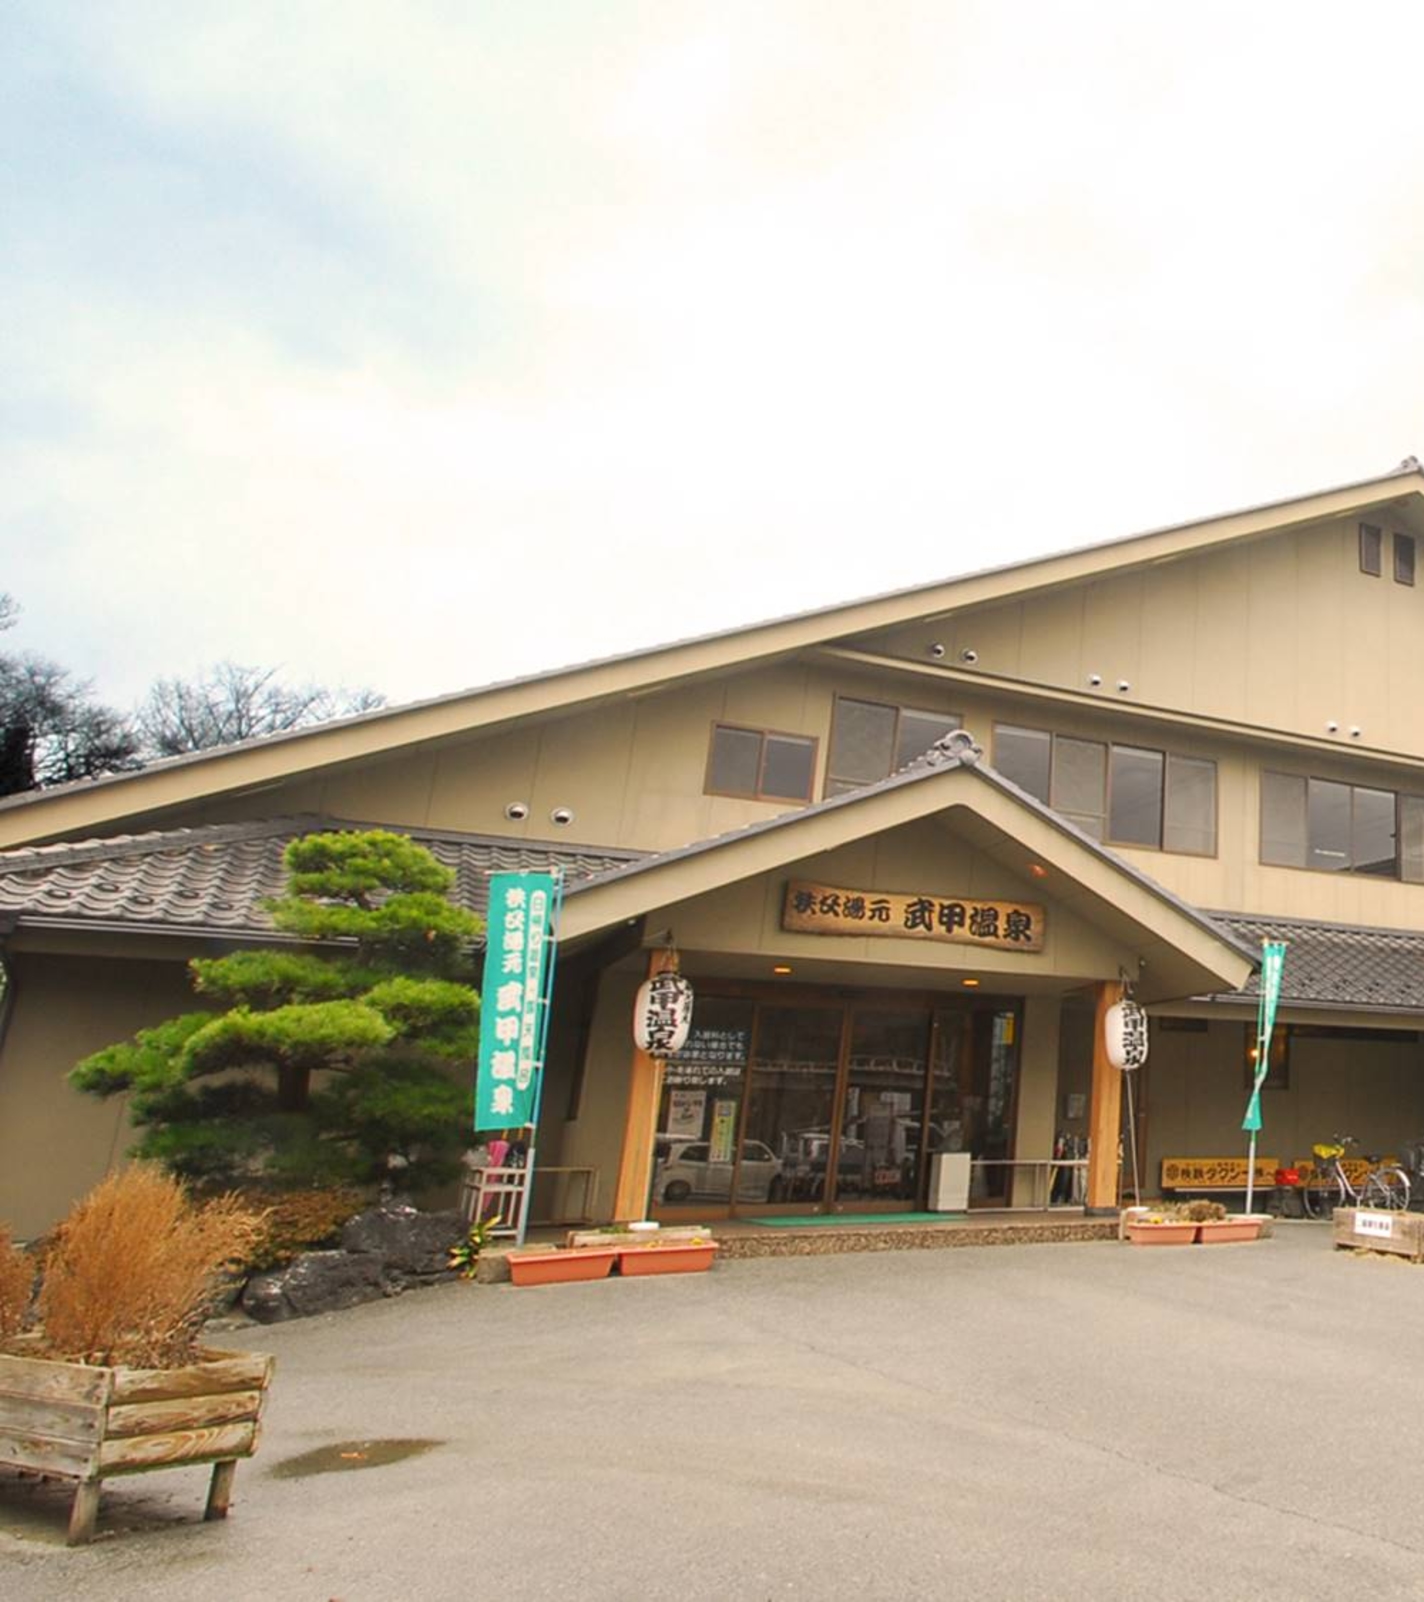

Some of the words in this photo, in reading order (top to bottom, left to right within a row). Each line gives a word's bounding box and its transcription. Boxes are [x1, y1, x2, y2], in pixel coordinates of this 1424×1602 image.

[502, 887, 526, 975] 秩父湯元
[793, 889, 891, 922] 秩父湯元
[903, 897, 1033, 942] 武甲温泉
[490, 981, 524, 1115] 武甲温泉
[645, 976, 684, 1050] 武甲温泉
